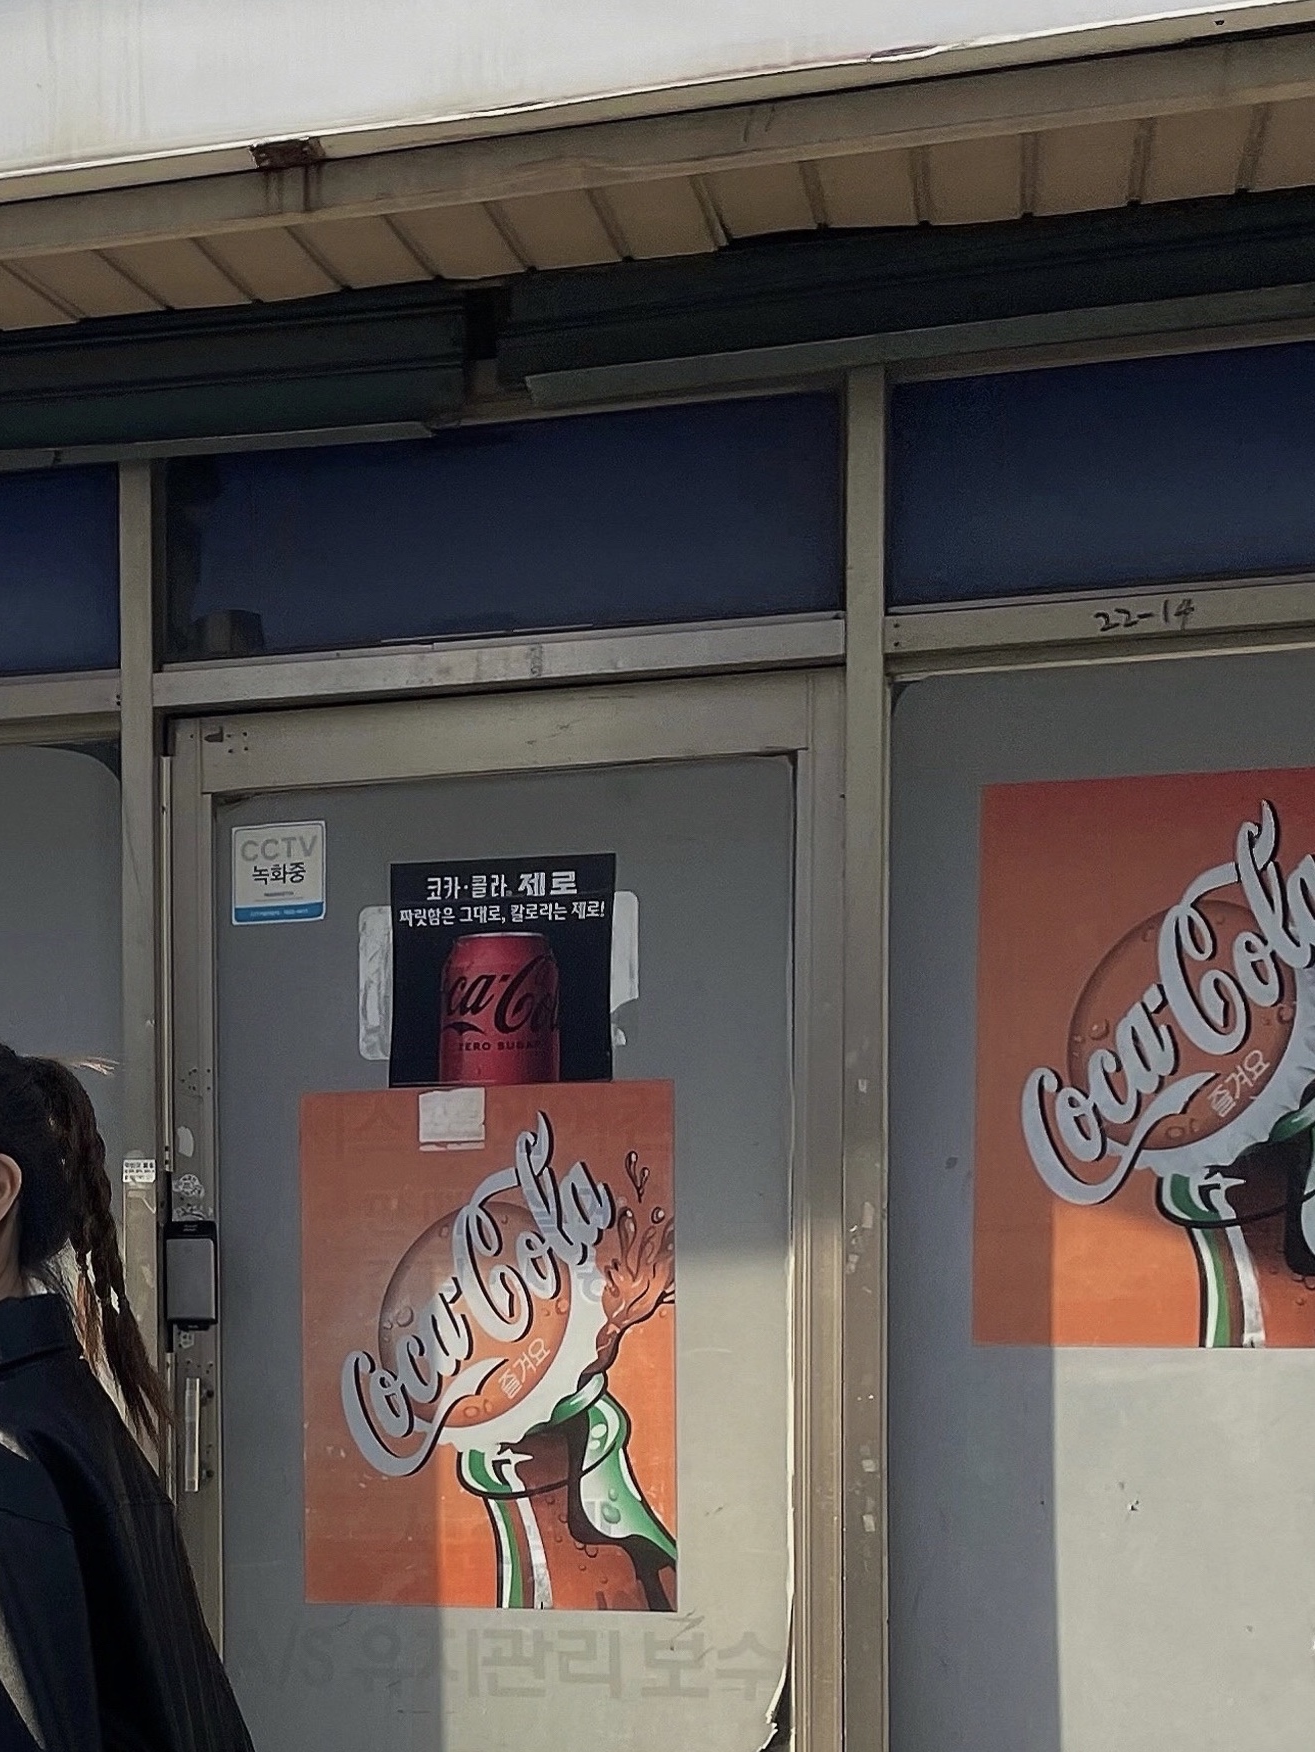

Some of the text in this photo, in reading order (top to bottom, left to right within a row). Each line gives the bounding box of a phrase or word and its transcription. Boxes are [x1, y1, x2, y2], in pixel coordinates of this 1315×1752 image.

[1093, 599, 1195, 632] 22-14
[240, 835, 319, 862] CCTV
[252, 861, 307, 886] 녹화중
[517, 870, 579, 898] 제로
[399, 901, 606, 927] 짜릿함은 그대로, 칼로리는 제로!
[458, 1041, 492, 1052] ZERO
[1208, 1049, 1270, 1117] 즐겨요
[342, 1111, 617, 1477] Coca-Cola
[498, 1338, 551, 1399] 즐겨요
[640, 1630, 784, 1702] 보수
